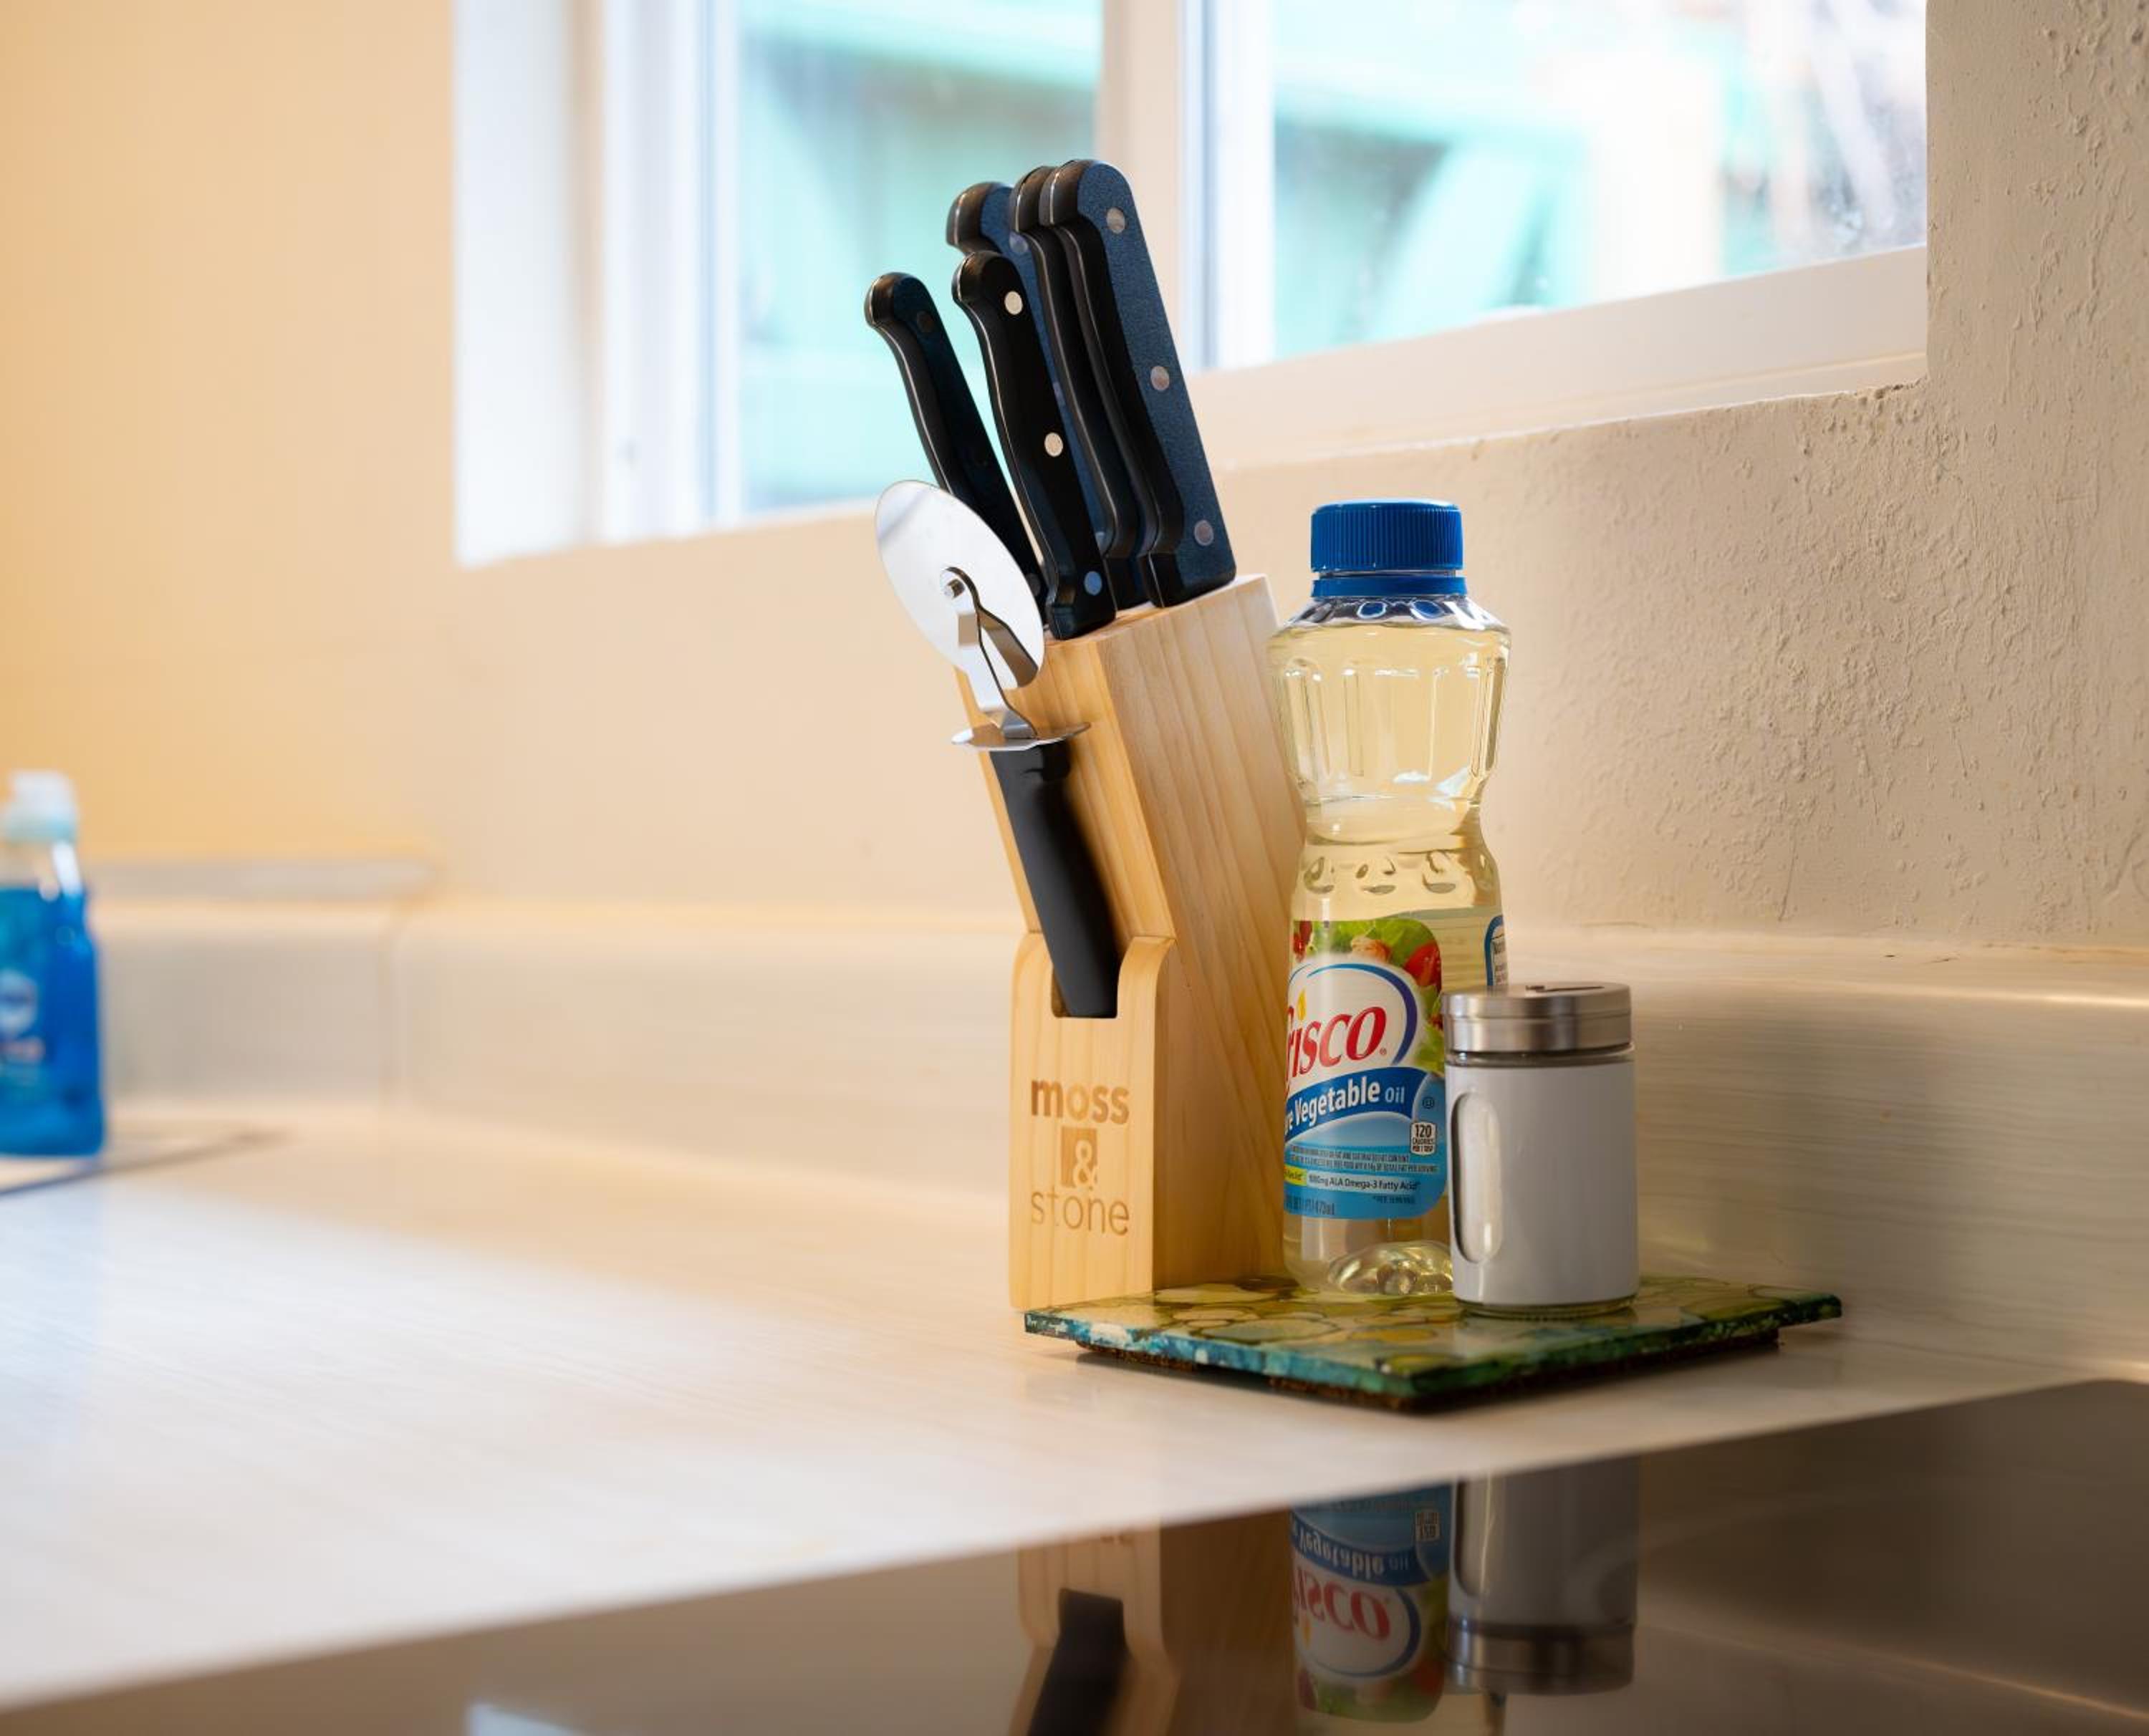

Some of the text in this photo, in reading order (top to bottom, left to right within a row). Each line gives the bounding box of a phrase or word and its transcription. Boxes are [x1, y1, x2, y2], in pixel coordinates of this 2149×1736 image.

[1284, 1006, 1387, 1078] risco
[1032, 1080, 1130, 1124] moss
[1294, 1076, 1380, 1126] Vegetable
[1385, 1086, 1405, 1104] oil
[1415, 1124, 1433, 1138] 120
[1068, 1134, 1098, 1189] &
[1345, 1178, 1377, 1190] Omega-3
[1379, 1180, 1398, 1192] Fatty
[1031, 1185, 1130, 1235] stone
